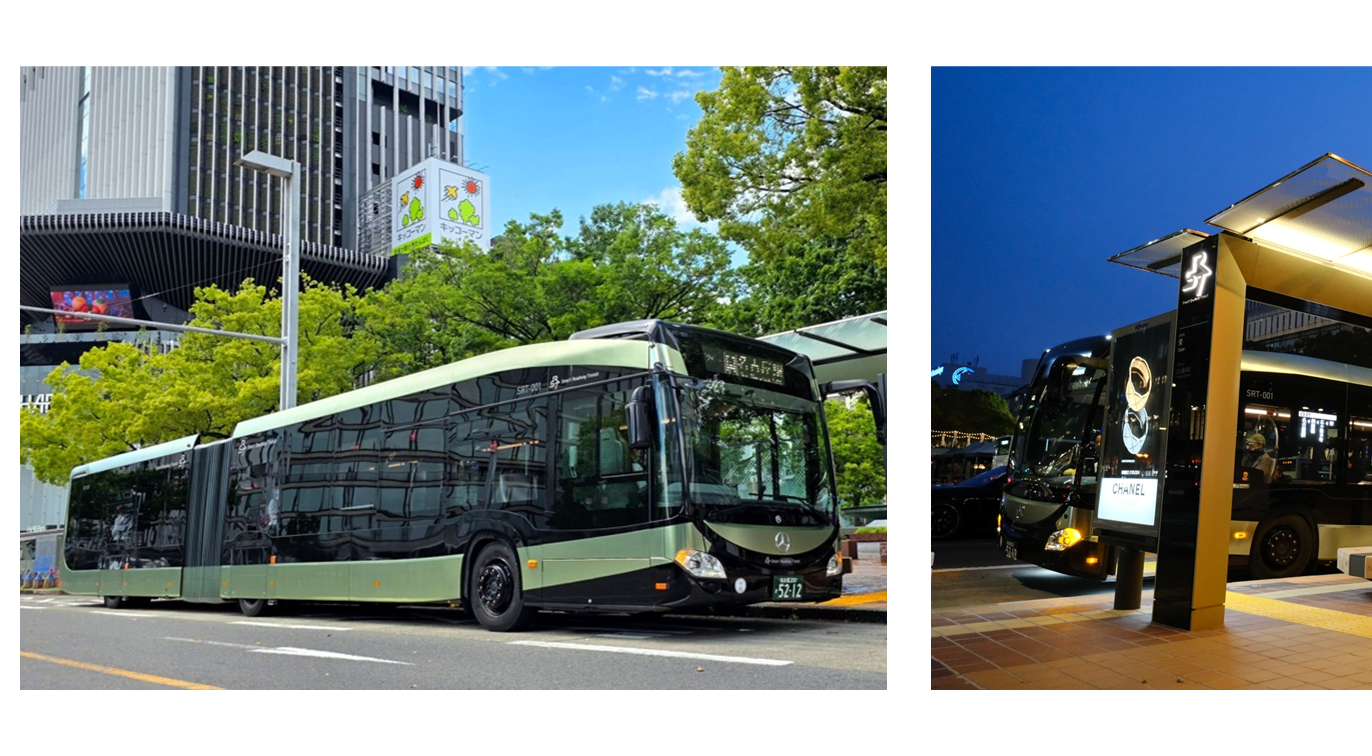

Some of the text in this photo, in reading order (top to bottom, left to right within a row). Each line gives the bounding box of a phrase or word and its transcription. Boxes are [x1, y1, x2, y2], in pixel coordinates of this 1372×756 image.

[397, 223, 426, 241] キッコーマン
[440, 222, 483, 239] キッコーマン
[516, 382, 541, 395] SRT-001
[1246, 389, 1274, 400] SRT-001
[1112, 482, 1145, 496] CHANEL
